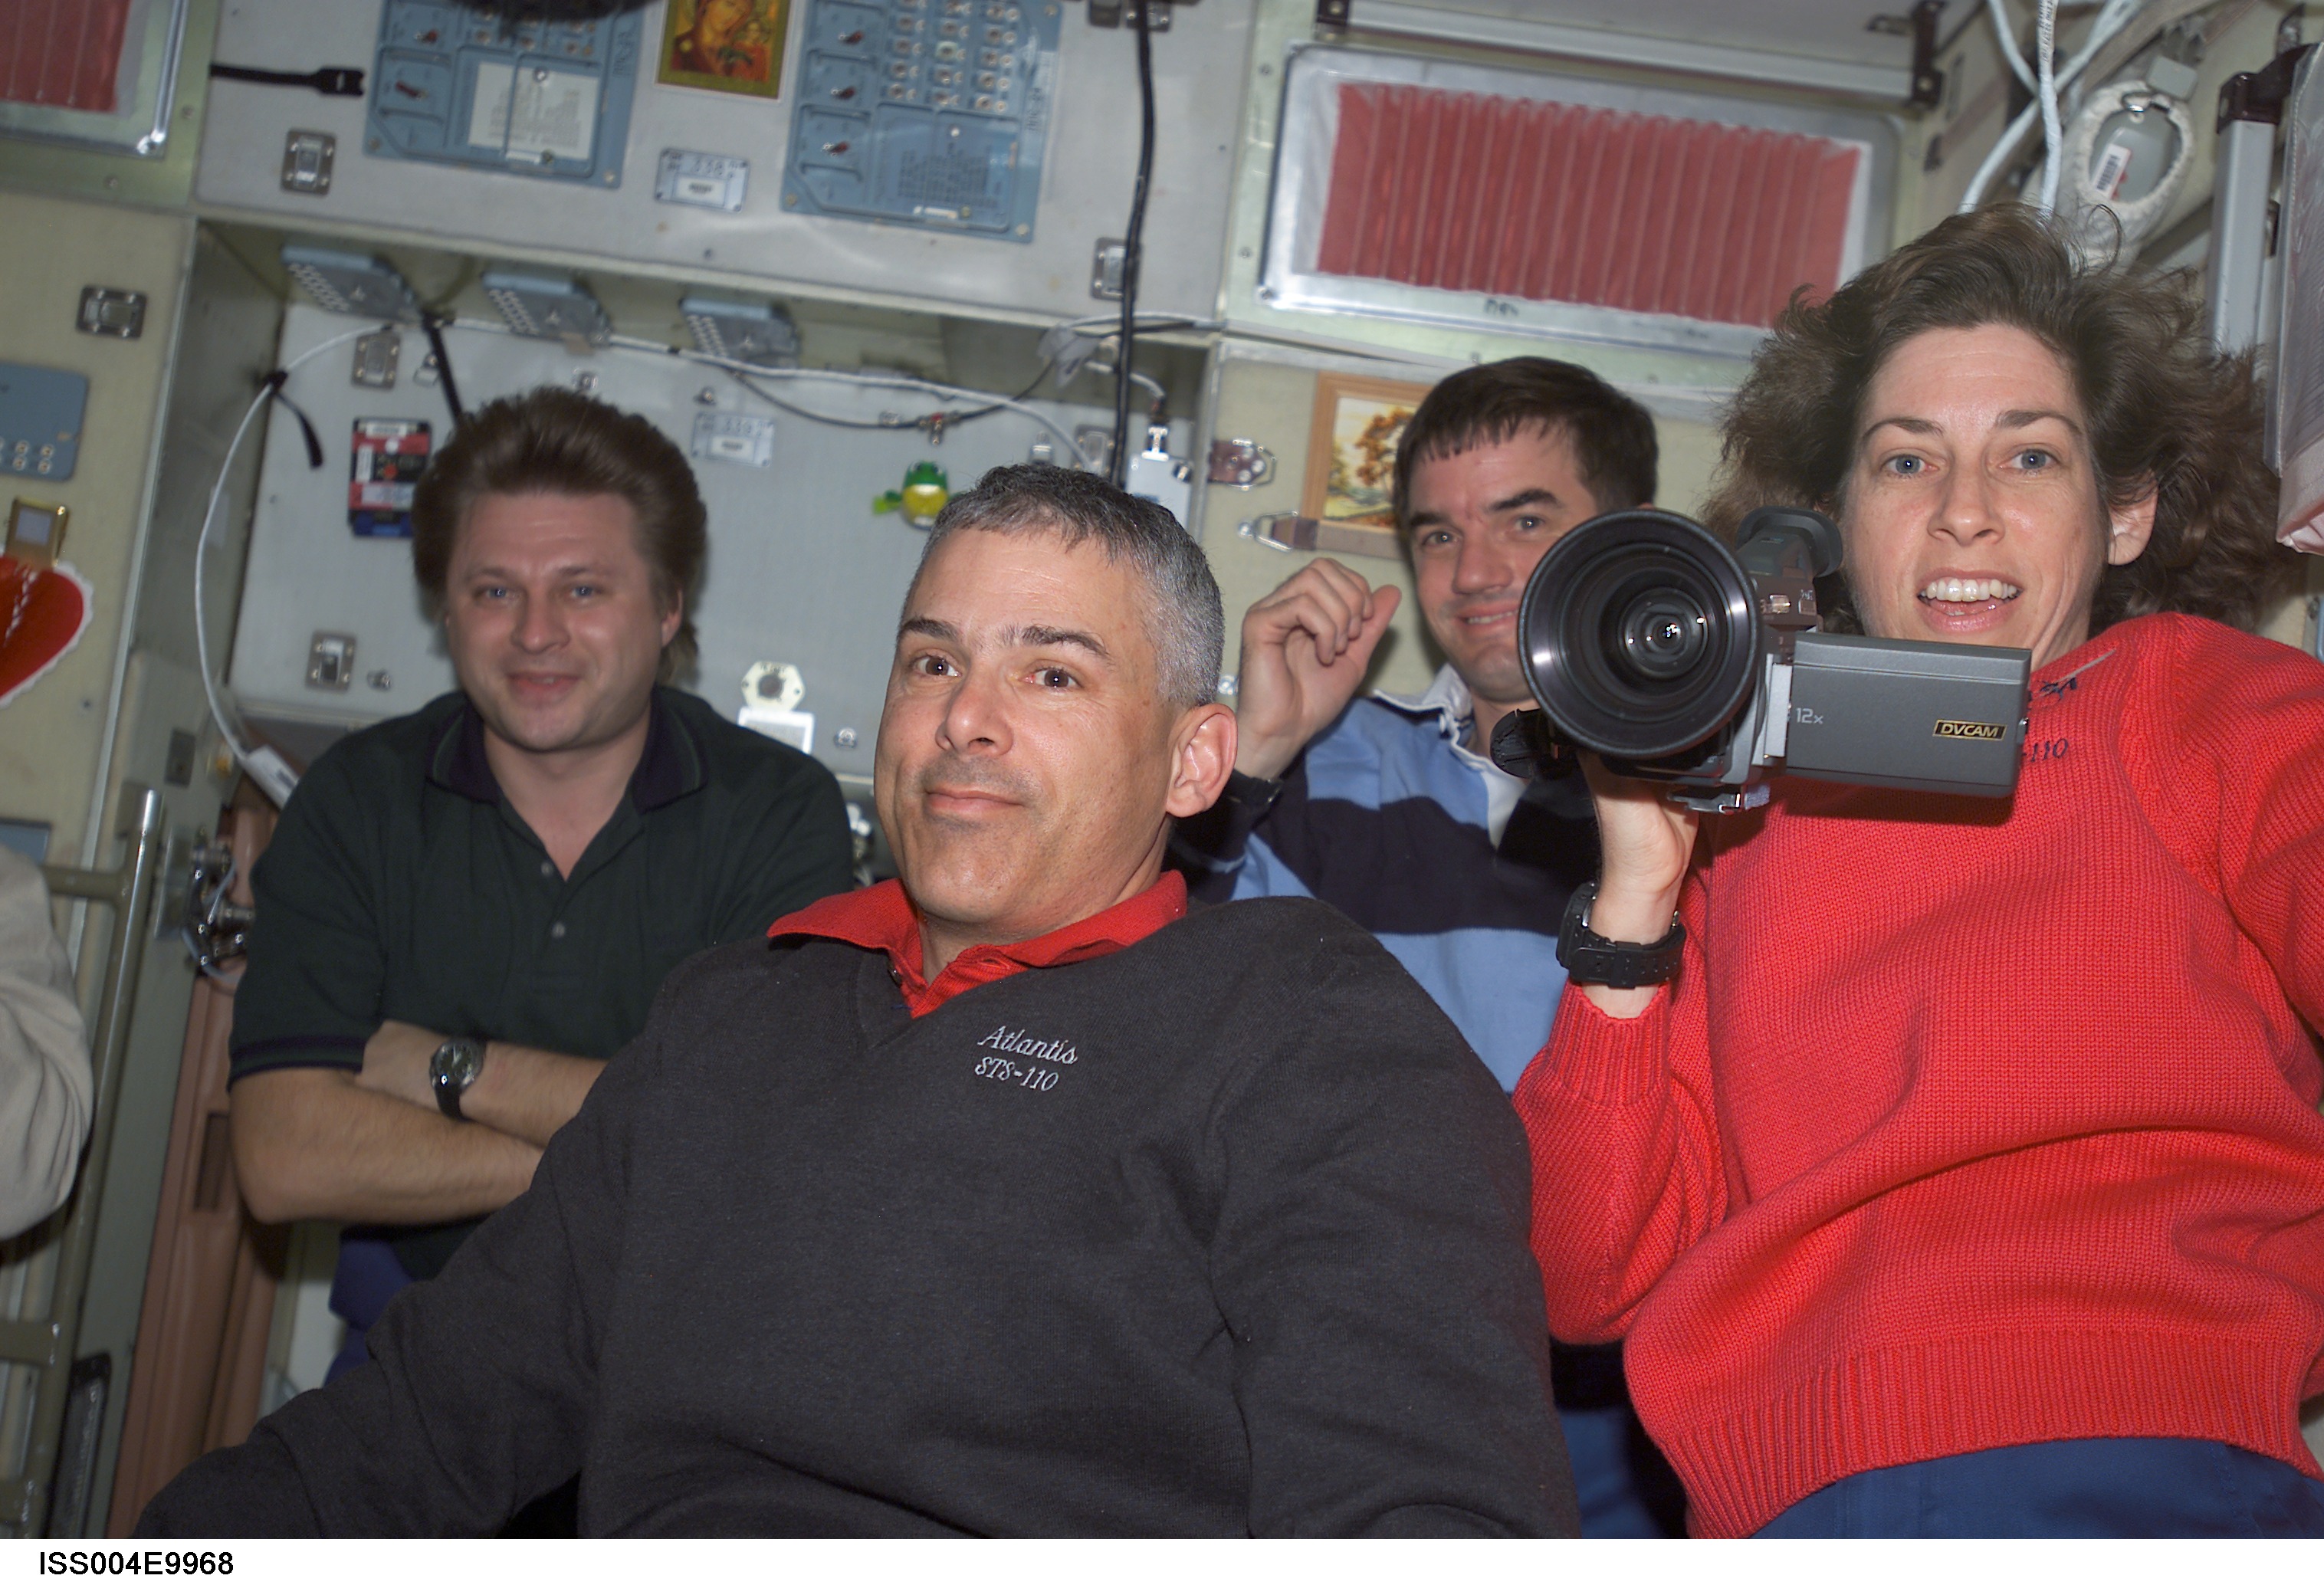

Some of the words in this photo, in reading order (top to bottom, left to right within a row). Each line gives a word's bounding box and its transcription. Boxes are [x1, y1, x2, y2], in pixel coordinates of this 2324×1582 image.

[1795, 707, 1824, 724] 12x
[1940, 723, 2000, 737] DVCAM
[977, 1026, 1078, 1065] Atlantis
[974, 1056, 1059, 1091] STS-110
